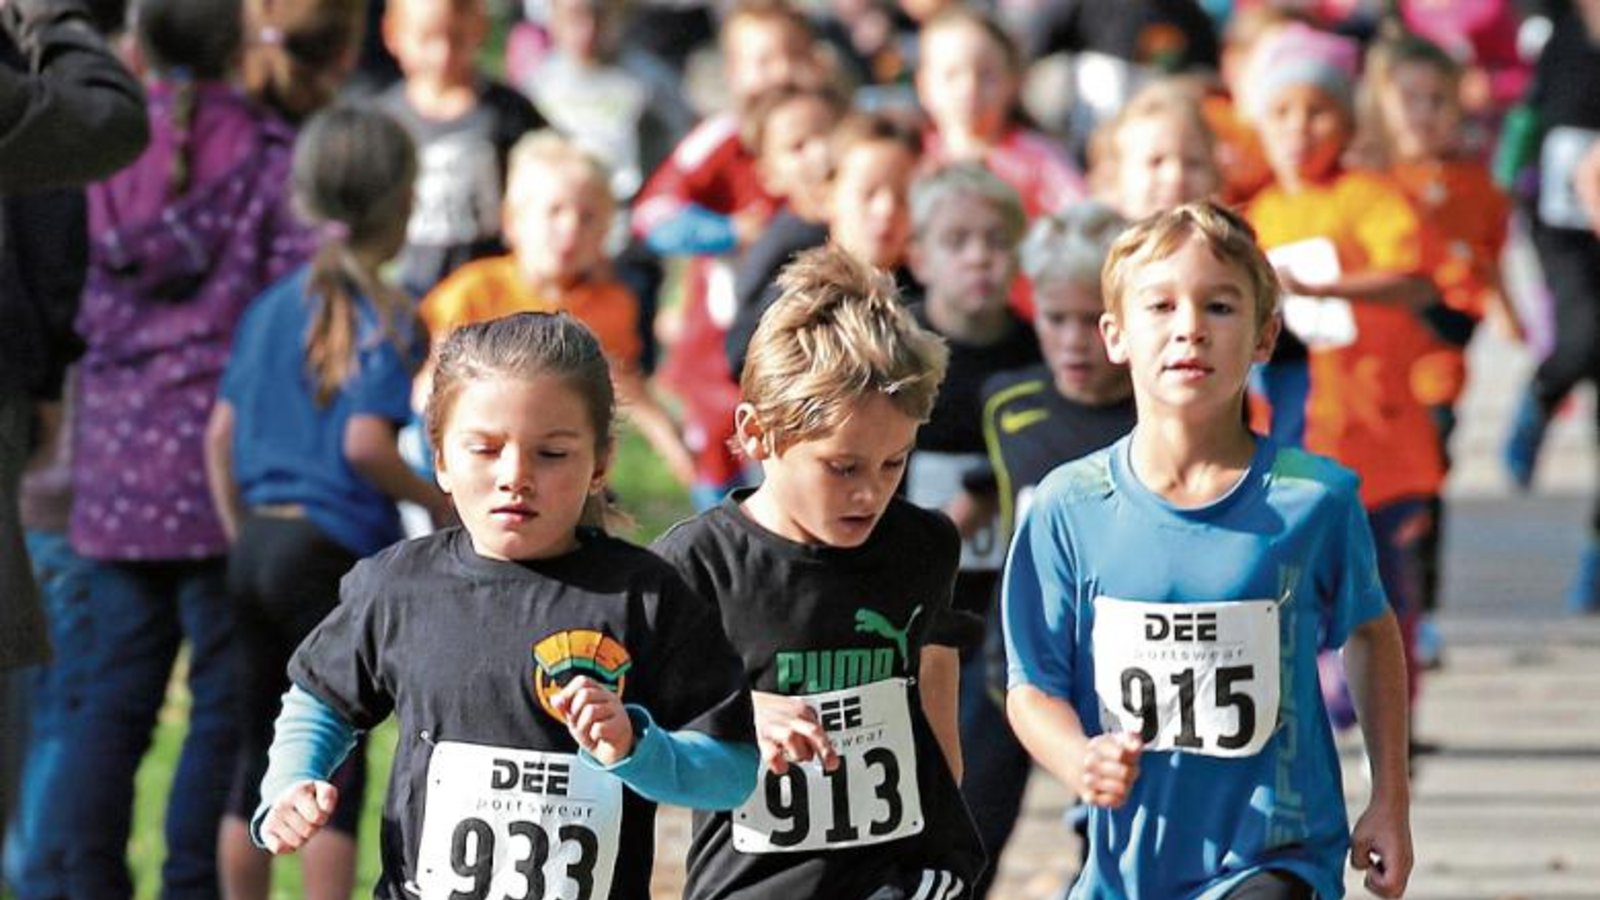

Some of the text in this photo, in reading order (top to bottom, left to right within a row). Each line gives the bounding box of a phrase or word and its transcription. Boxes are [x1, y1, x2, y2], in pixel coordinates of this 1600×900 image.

[1145, 612, 1217, 642] DEE
[776, 648, 894, 693] PUMA
[808, 696, 863, 731] EE
[1120, 664, 1256, 750] 915
[490, 758, 570, 796] DEE
[765, 747, 904, 847] 913
[450, 817, 599, 900] 933
